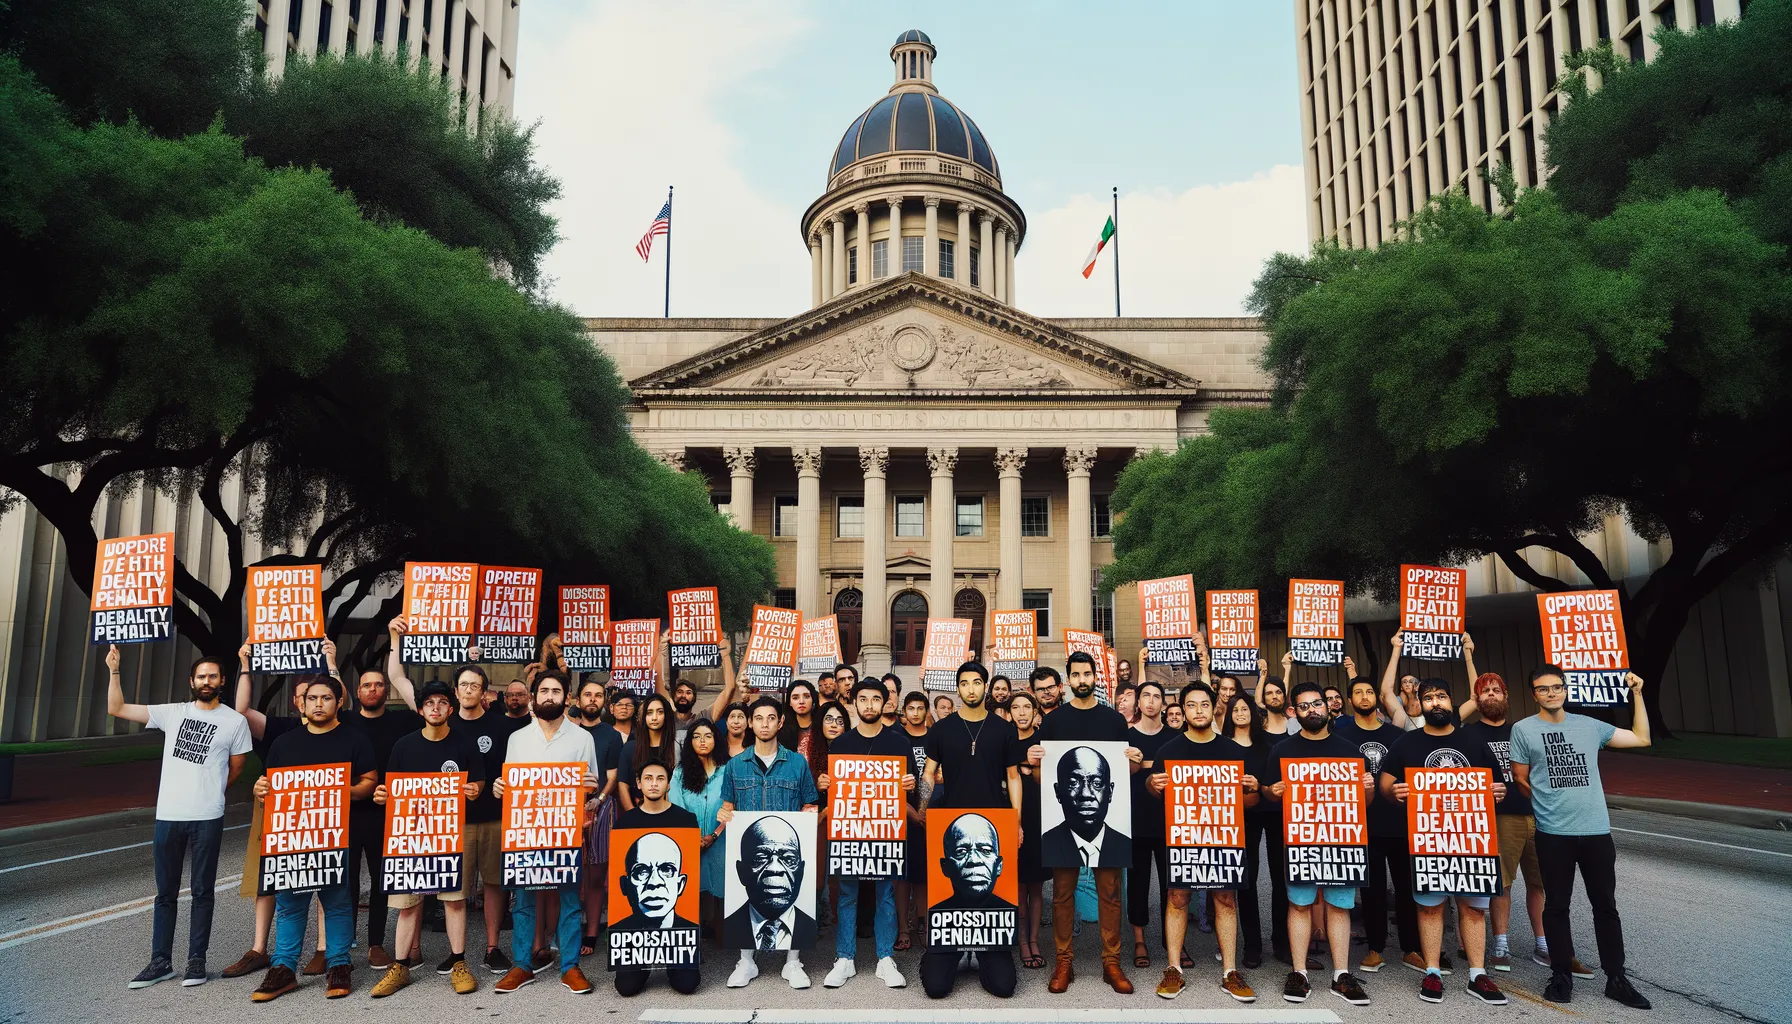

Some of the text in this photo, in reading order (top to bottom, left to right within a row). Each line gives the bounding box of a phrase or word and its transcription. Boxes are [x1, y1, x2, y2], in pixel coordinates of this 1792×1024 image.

[1287, 762, 1359, 782] OPPOSSE
[1174, 805, 1235, 825] DEATH
[266, 828, 343, 854] PENALTY
[1170, 826, 1239, 846] PENALTY
[1413, 833, 1490, 854] PENALTY
[1170, 865, 1245, 883] PENALTY
[1416, 873, 1497, 893] PENALTY
